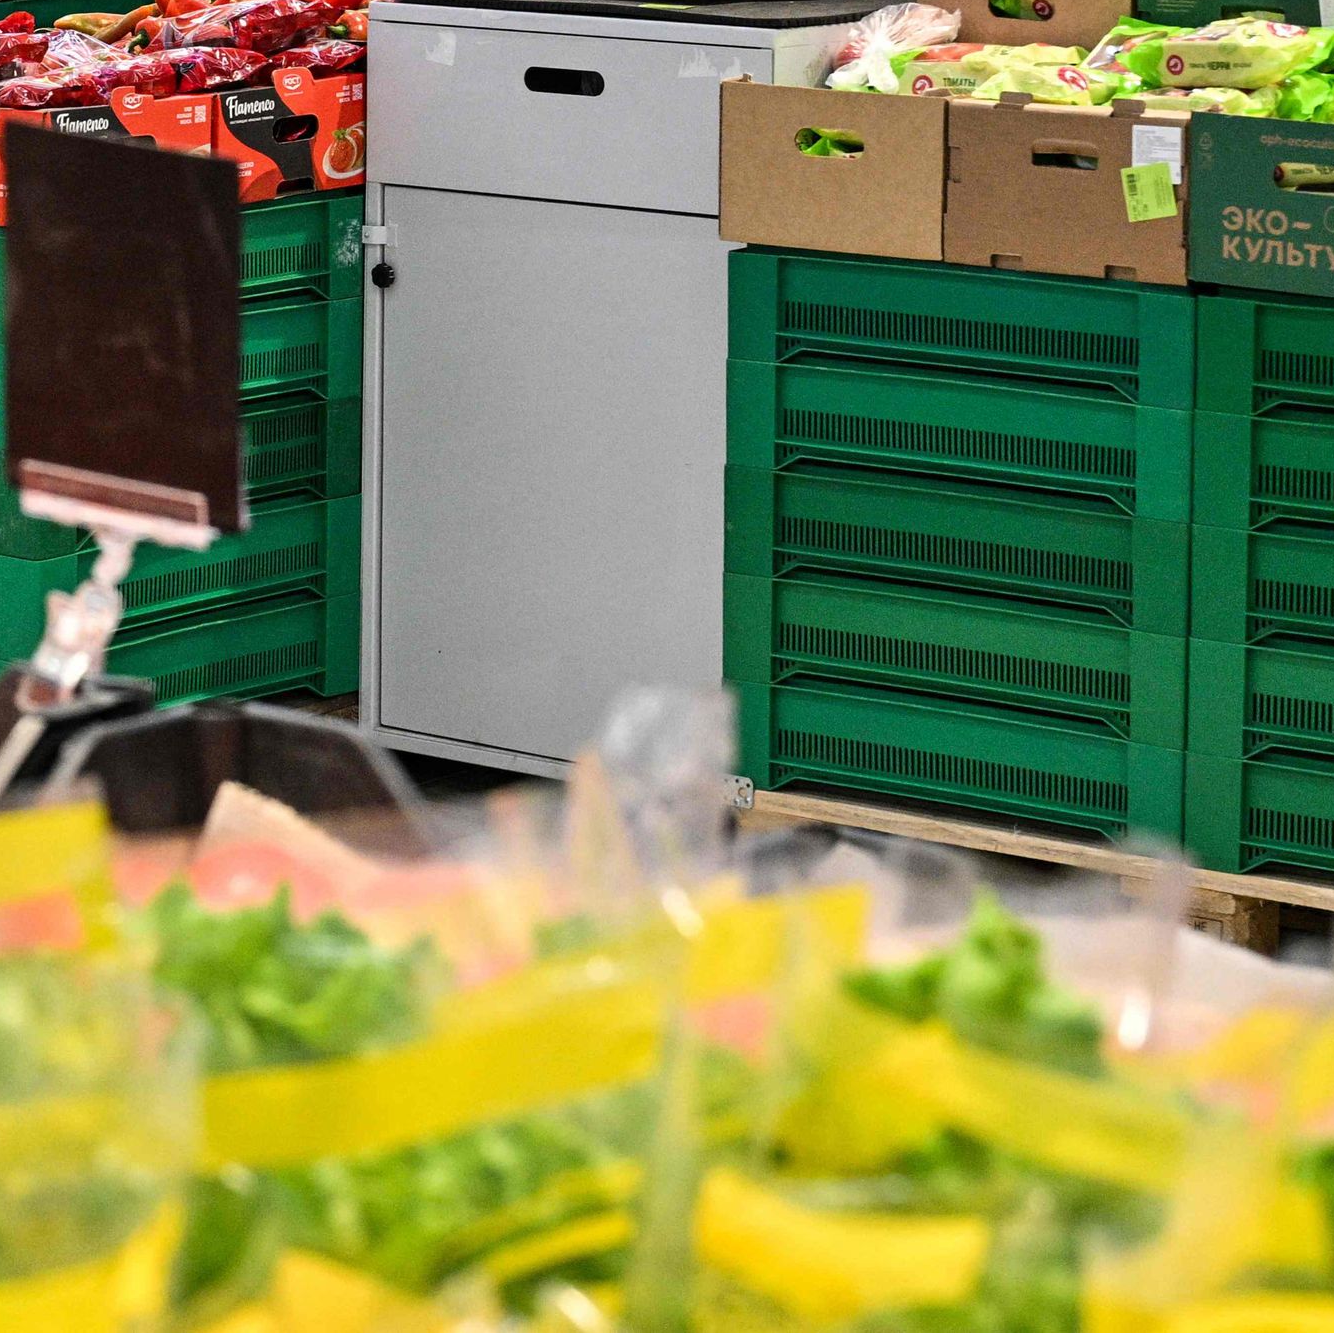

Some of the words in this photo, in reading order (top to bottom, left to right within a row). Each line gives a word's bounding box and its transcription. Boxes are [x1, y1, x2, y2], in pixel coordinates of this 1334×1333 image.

[226, 95, 275, 119] Flamenco
[56, 113, 110, 134] Flamenco
[1221, 205, 1313, 236] ЭКО-
